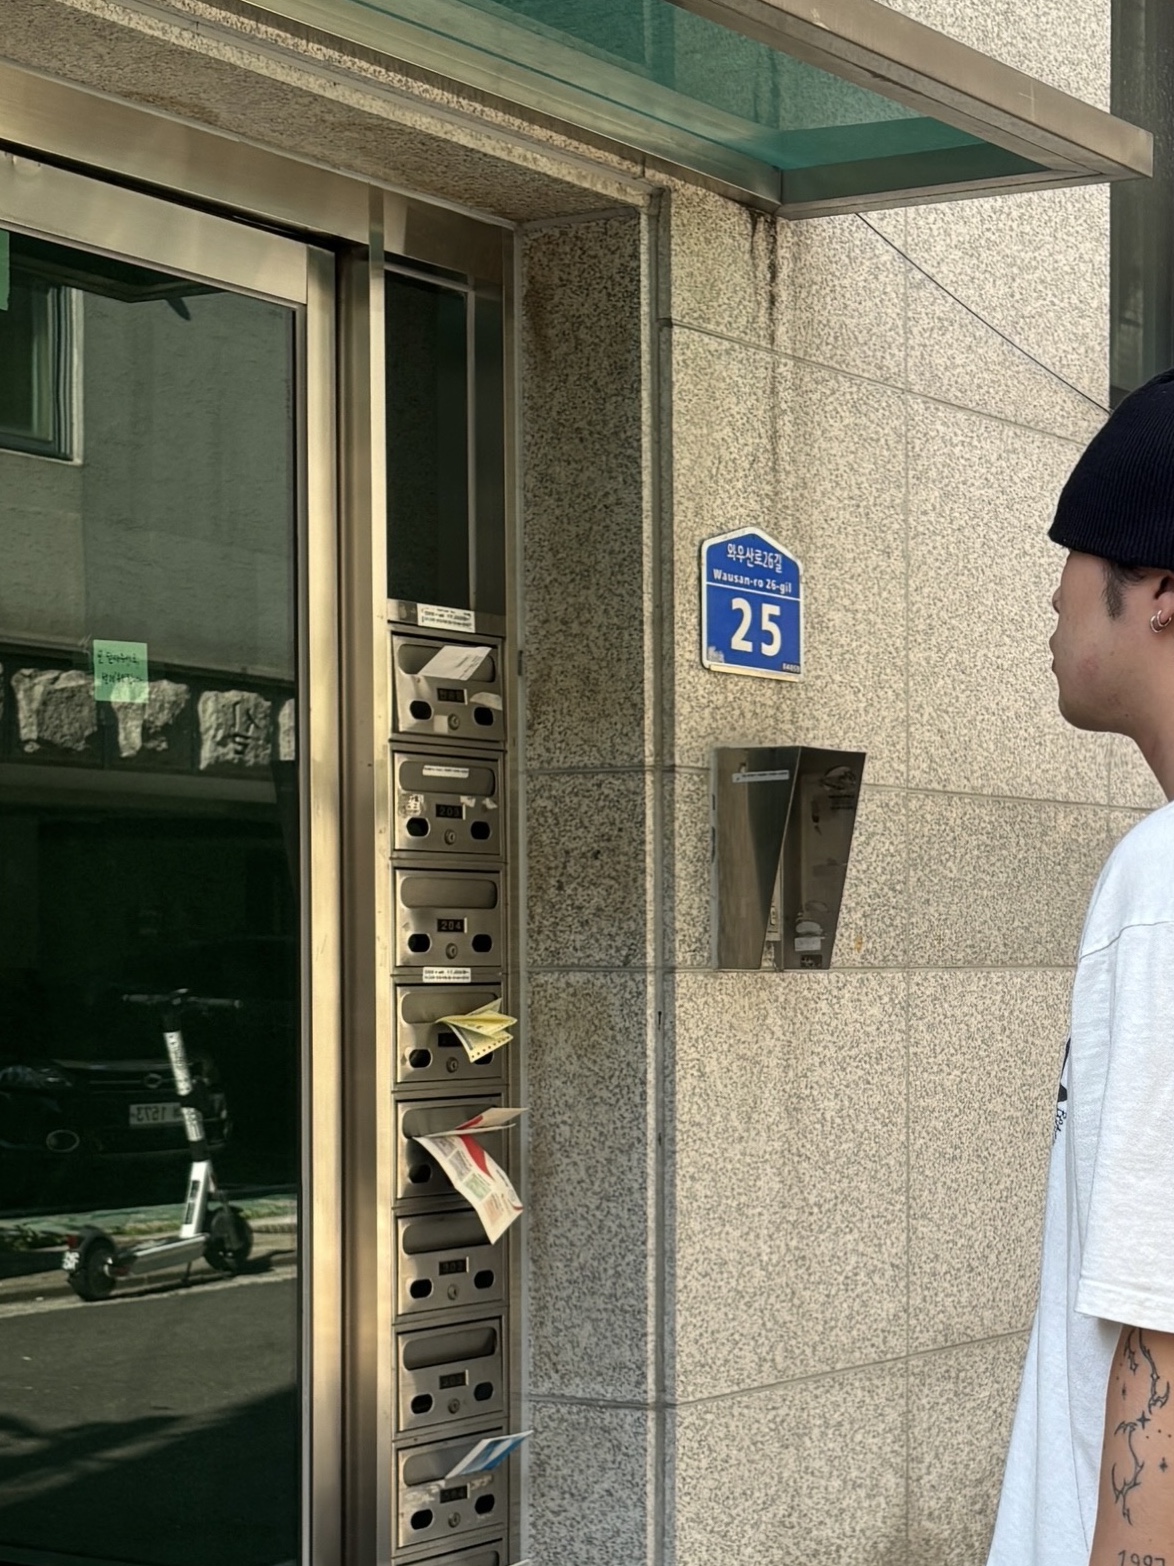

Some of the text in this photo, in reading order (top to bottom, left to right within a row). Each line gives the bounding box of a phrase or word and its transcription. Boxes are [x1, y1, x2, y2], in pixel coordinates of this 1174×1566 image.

[727, 543, 782, 573] 와우산로26길
[713, 569, 792, 595] Wausan-ro 26-gil
[731, 597, 782, 657] 25
[440, 920, 462, 931] 204
